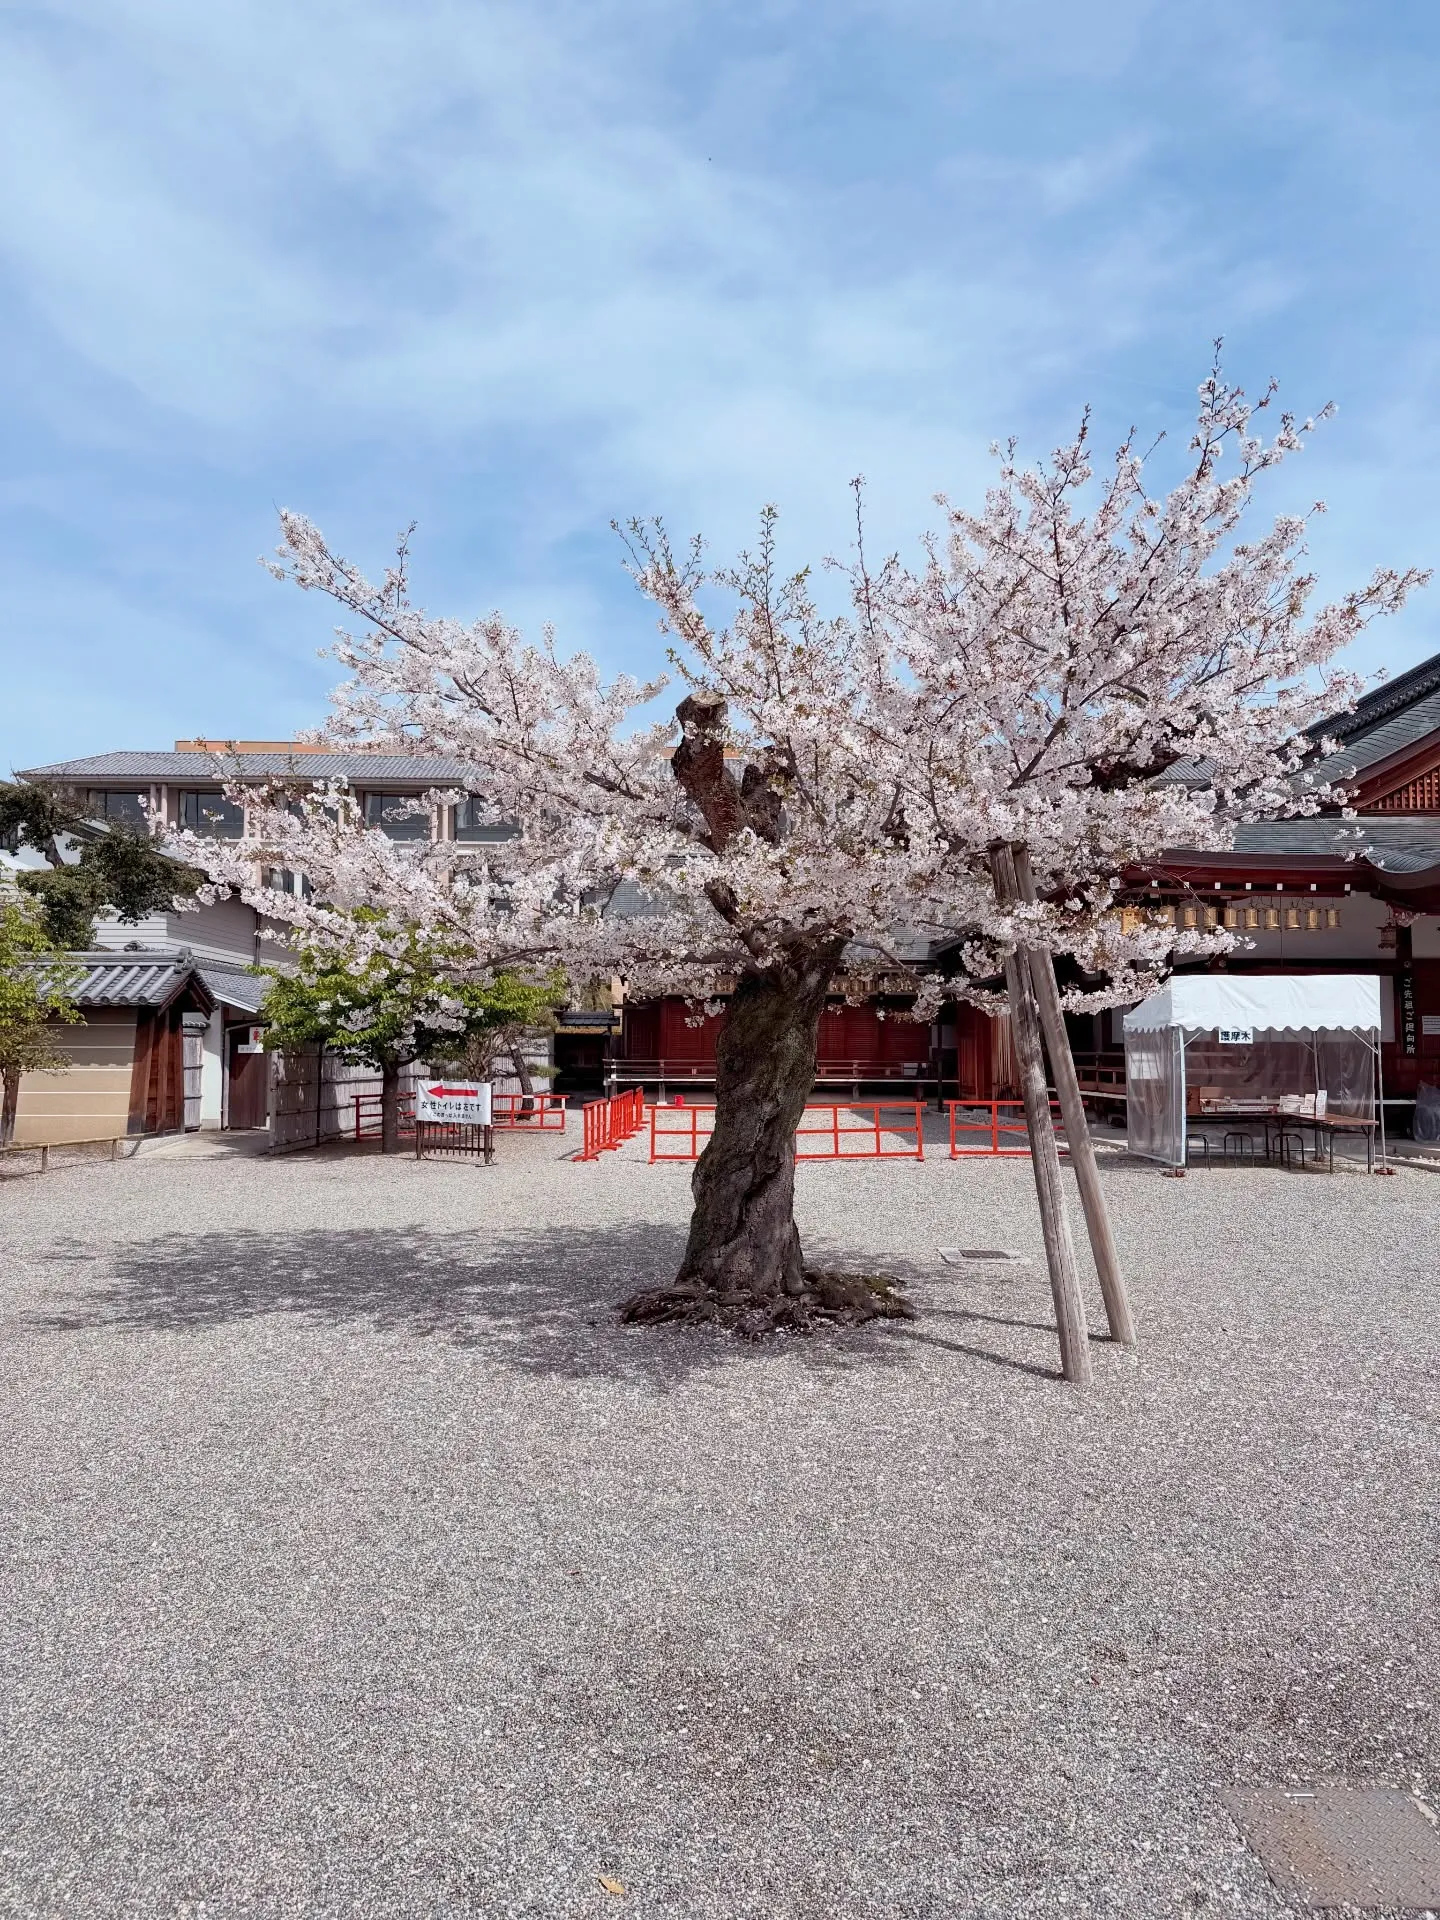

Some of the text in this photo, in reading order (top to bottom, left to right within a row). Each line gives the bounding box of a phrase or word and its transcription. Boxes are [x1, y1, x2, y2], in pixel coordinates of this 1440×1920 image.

[421, 1101, 482, 1112] 女性トイレは左です
